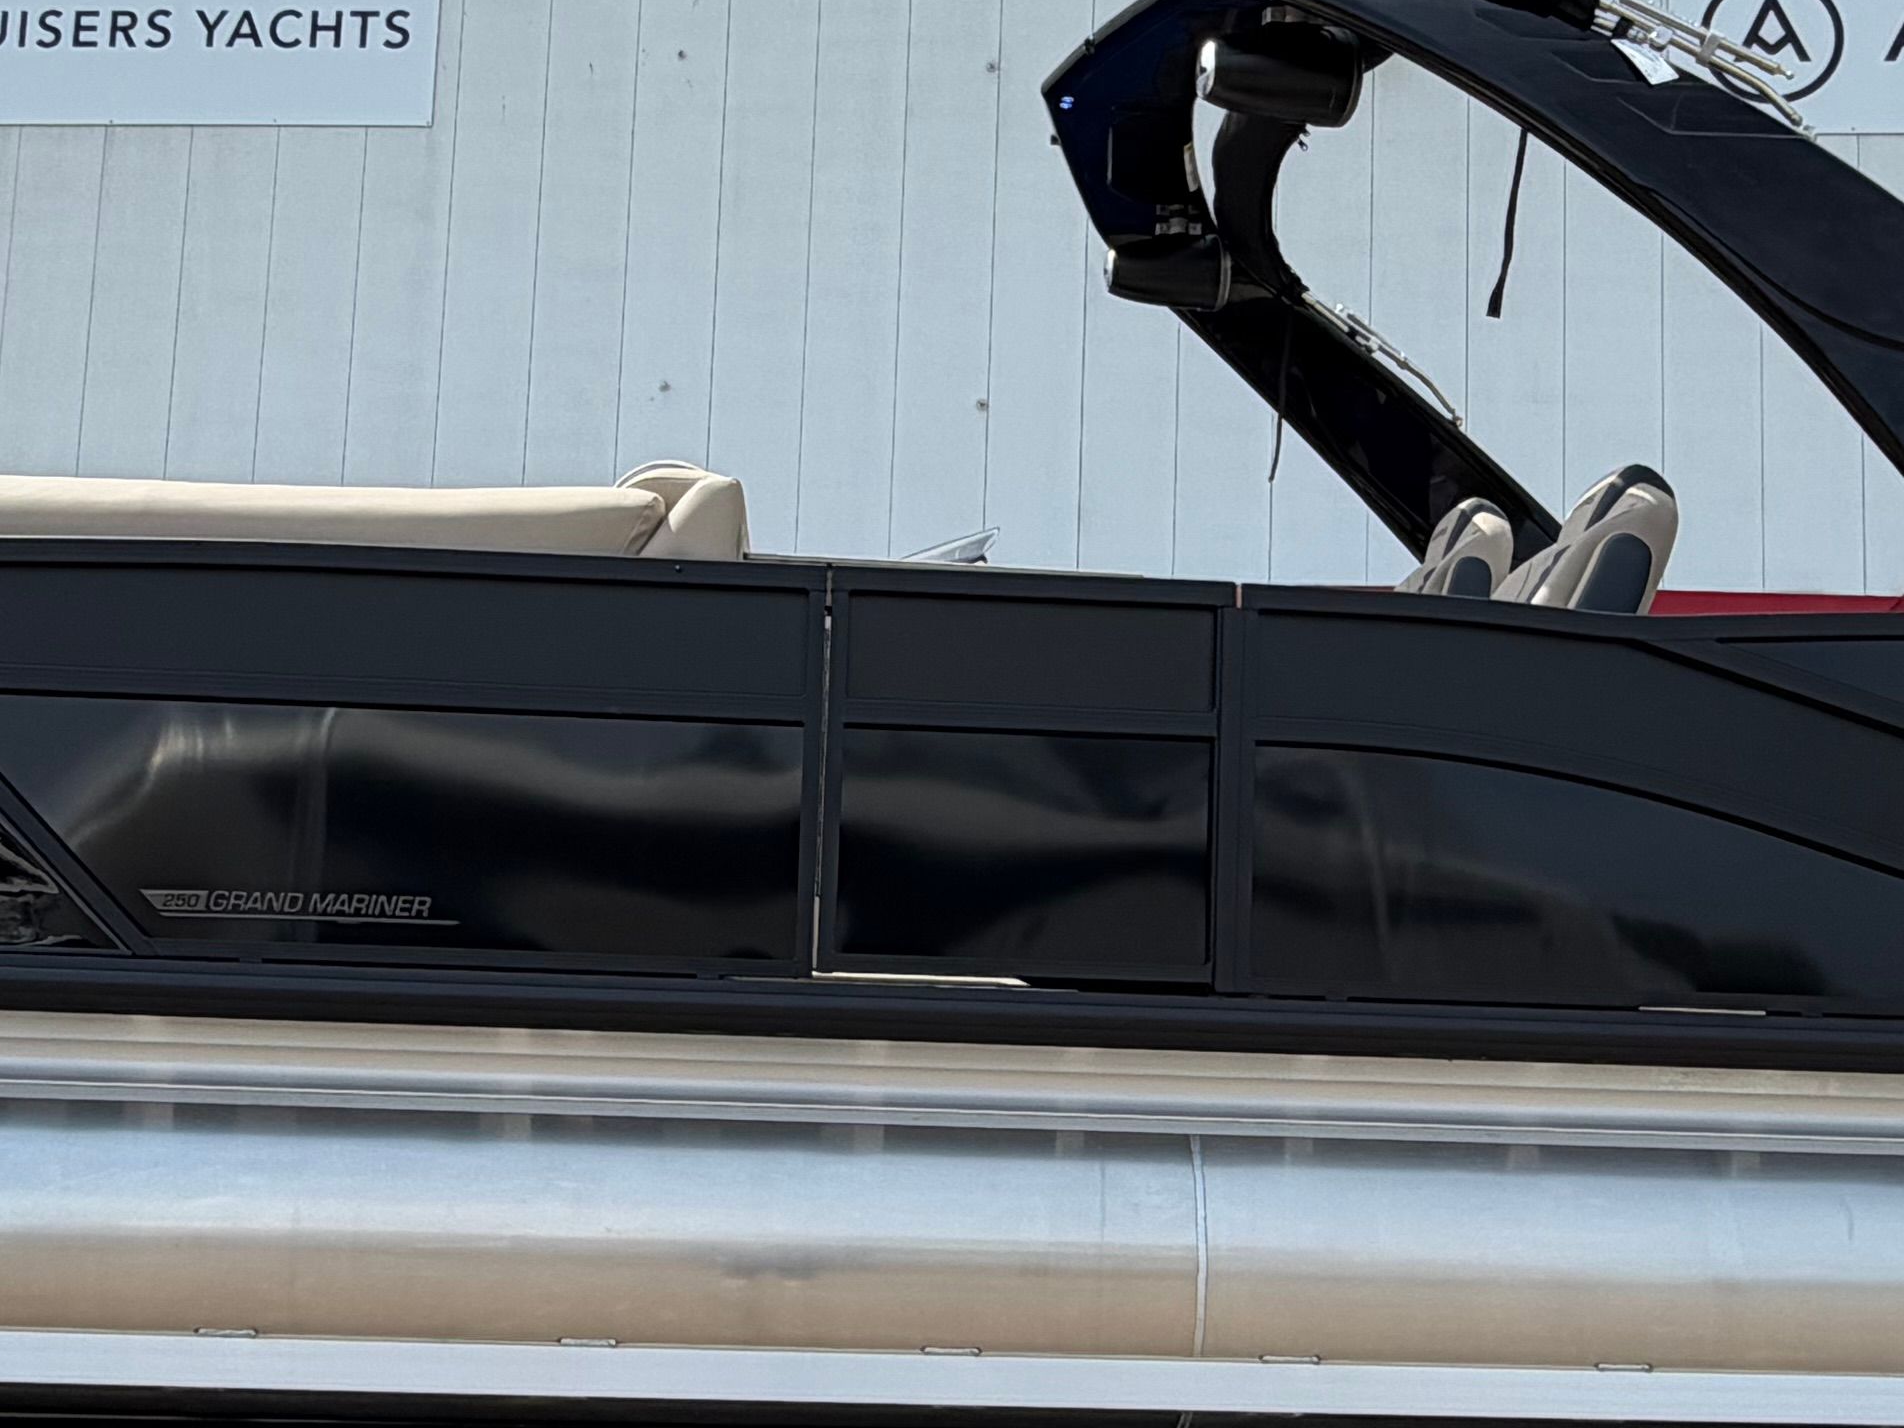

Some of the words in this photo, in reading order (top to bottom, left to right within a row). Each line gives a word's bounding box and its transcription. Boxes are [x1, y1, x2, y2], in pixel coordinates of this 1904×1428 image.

[196, 9, 410, 49] YACHTS
[163, 893, 200, 908] 250
[208, 890, 304, 914] GRAND
[308, 893, 432, 918] MARINER
